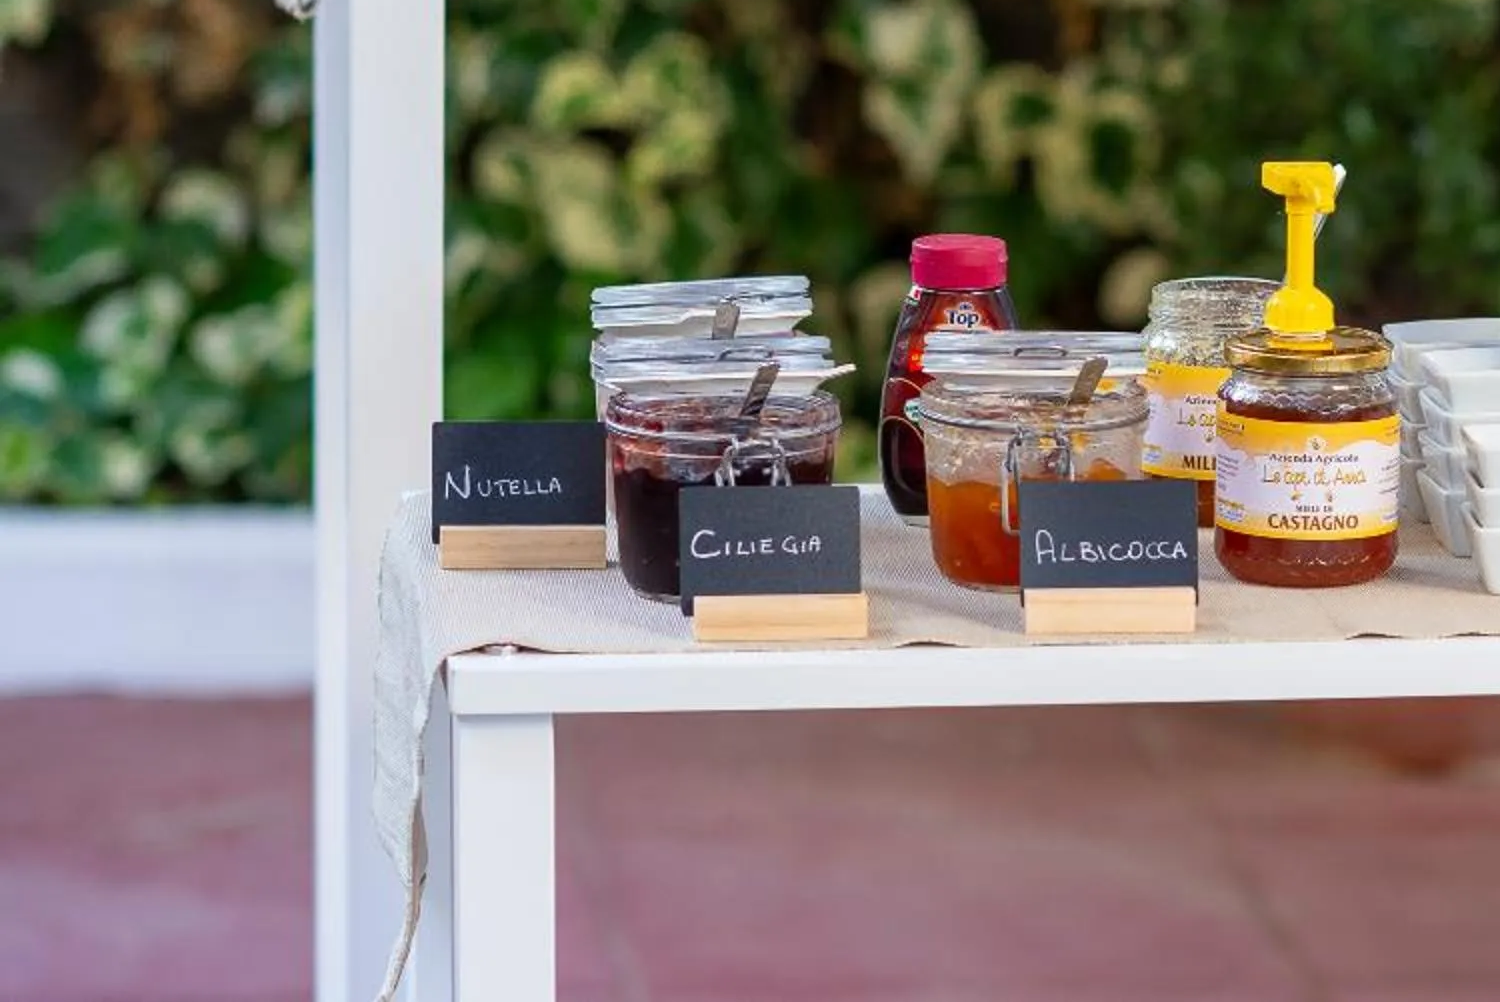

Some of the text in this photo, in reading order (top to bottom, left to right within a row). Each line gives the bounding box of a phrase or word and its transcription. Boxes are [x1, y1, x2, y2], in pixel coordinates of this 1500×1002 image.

[946, 309, 980, 328] Top
[1269, 454, 1313, 463] Azienda
[1267, 513, 1360, 531] CASTAGNO
[690, 529, 822, 558] CILIEGIA
[1035, 529, 1188, 564] ALBICOCCA
